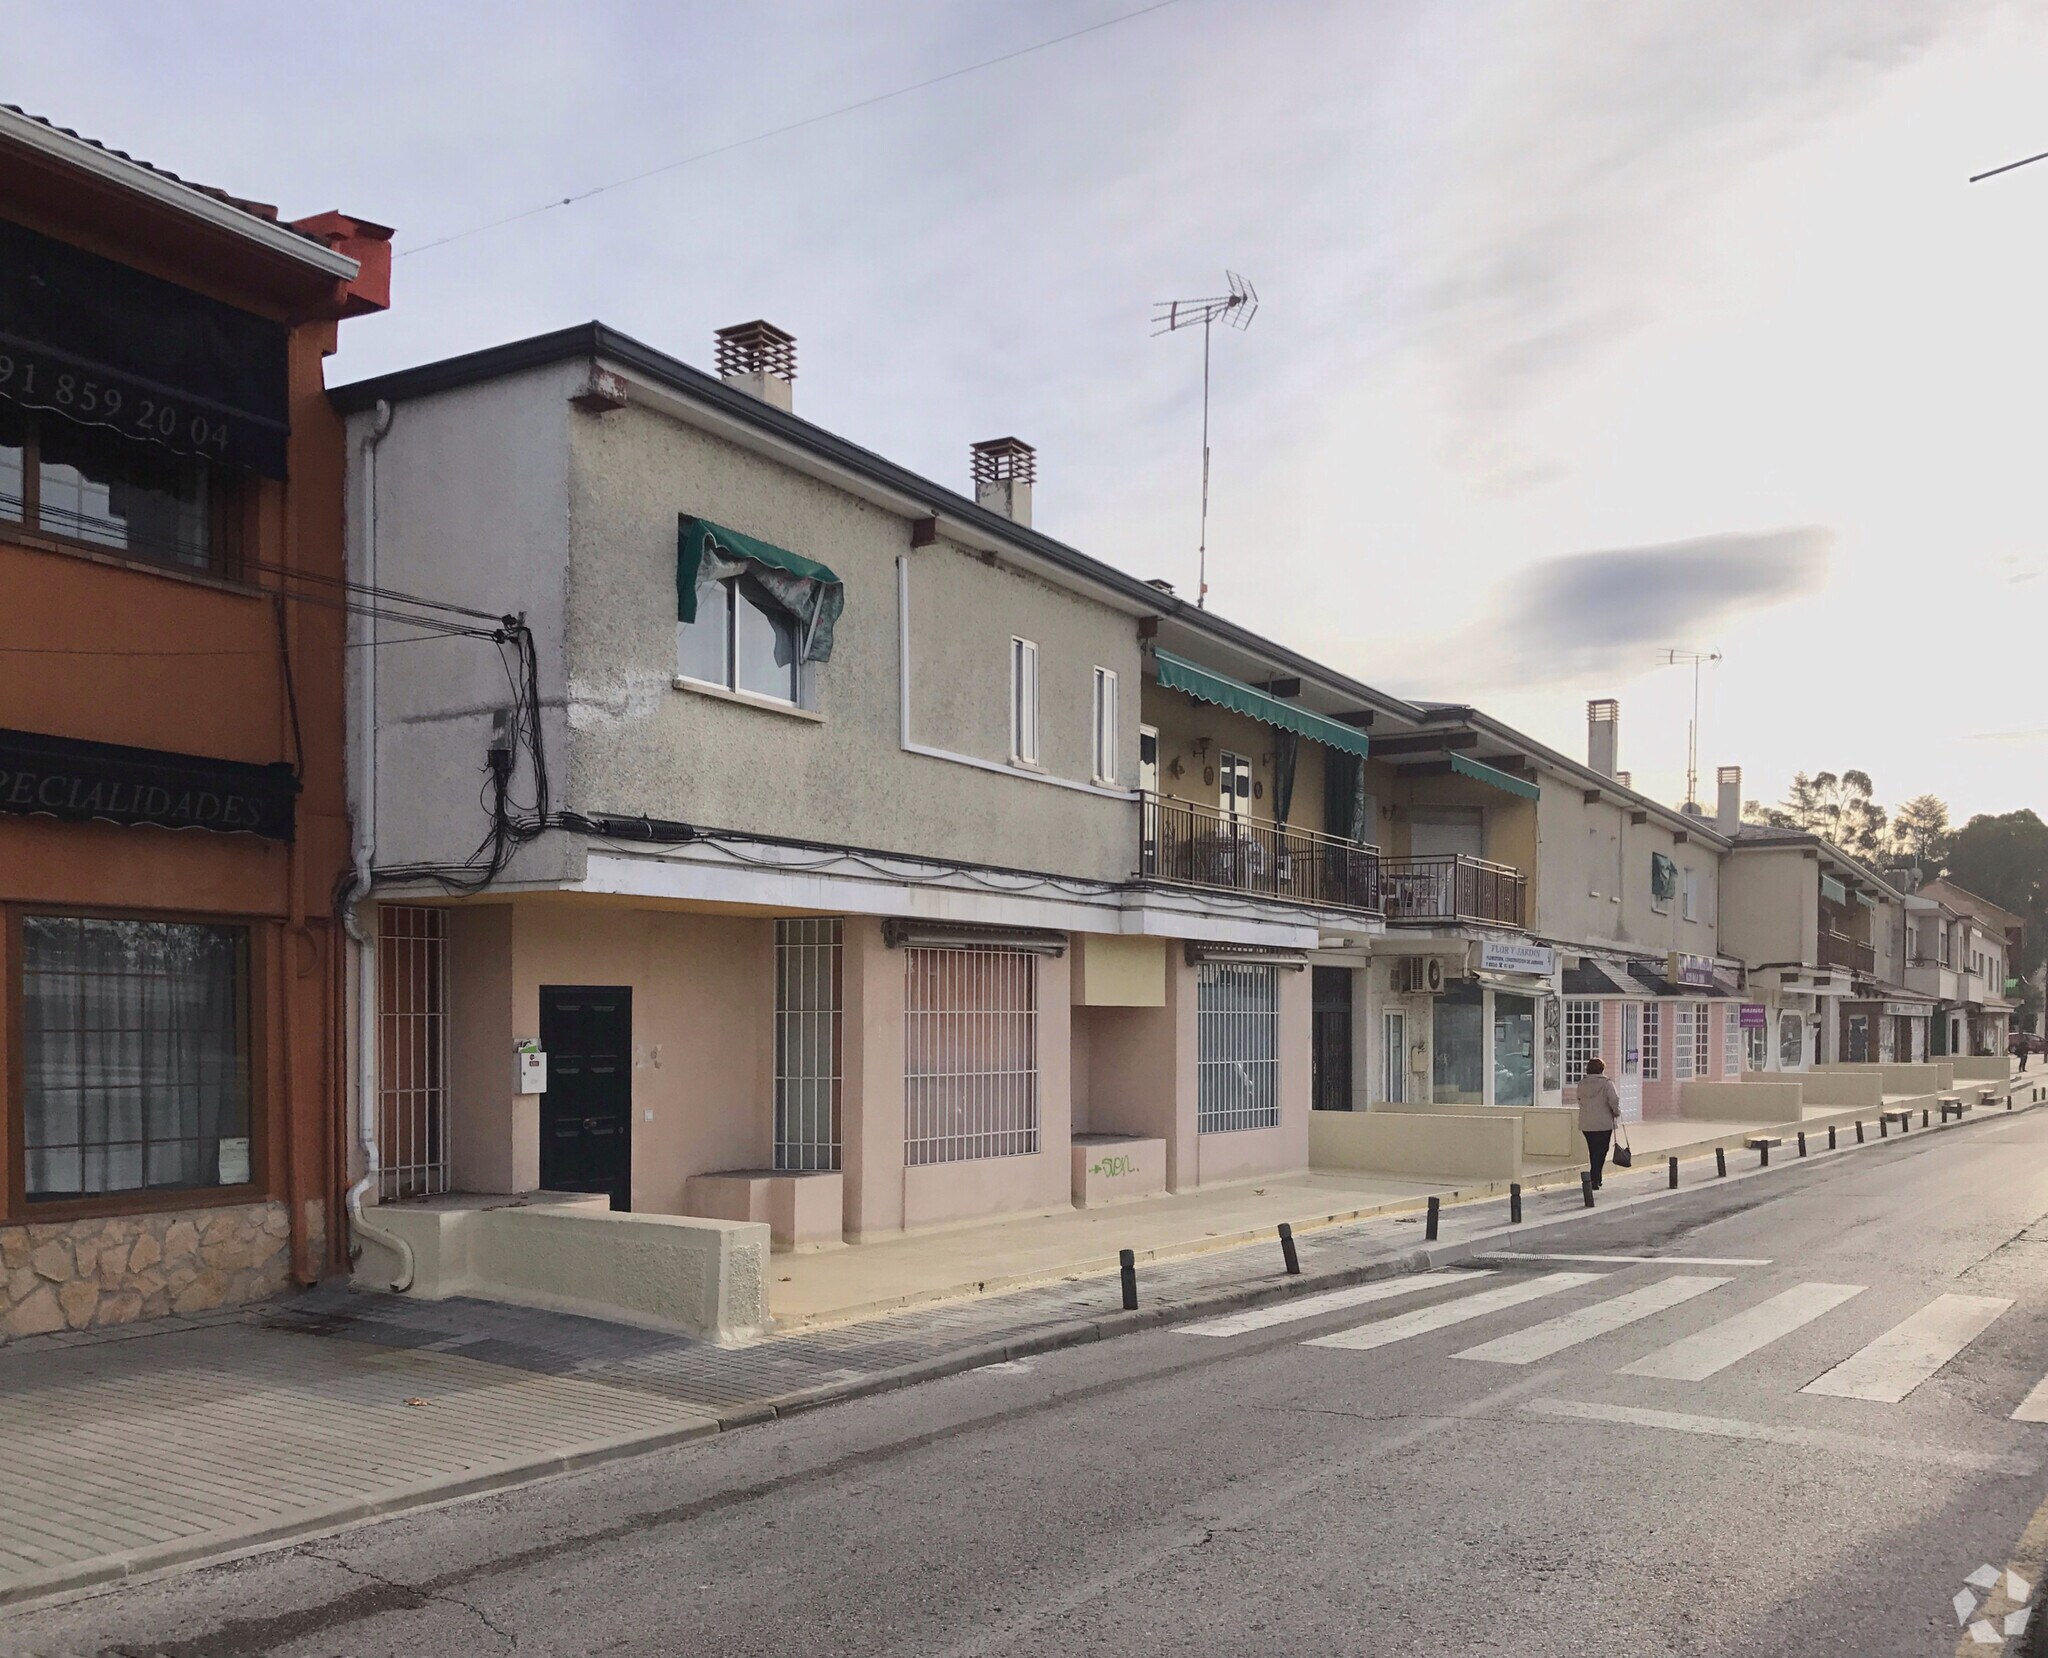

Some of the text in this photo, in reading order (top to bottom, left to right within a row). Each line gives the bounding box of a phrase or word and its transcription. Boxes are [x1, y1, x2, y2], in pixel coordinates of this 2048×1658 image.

[0, 355, 230, 451] 91 859 20 04
[1491, 945, 1509, 955] FLOR
